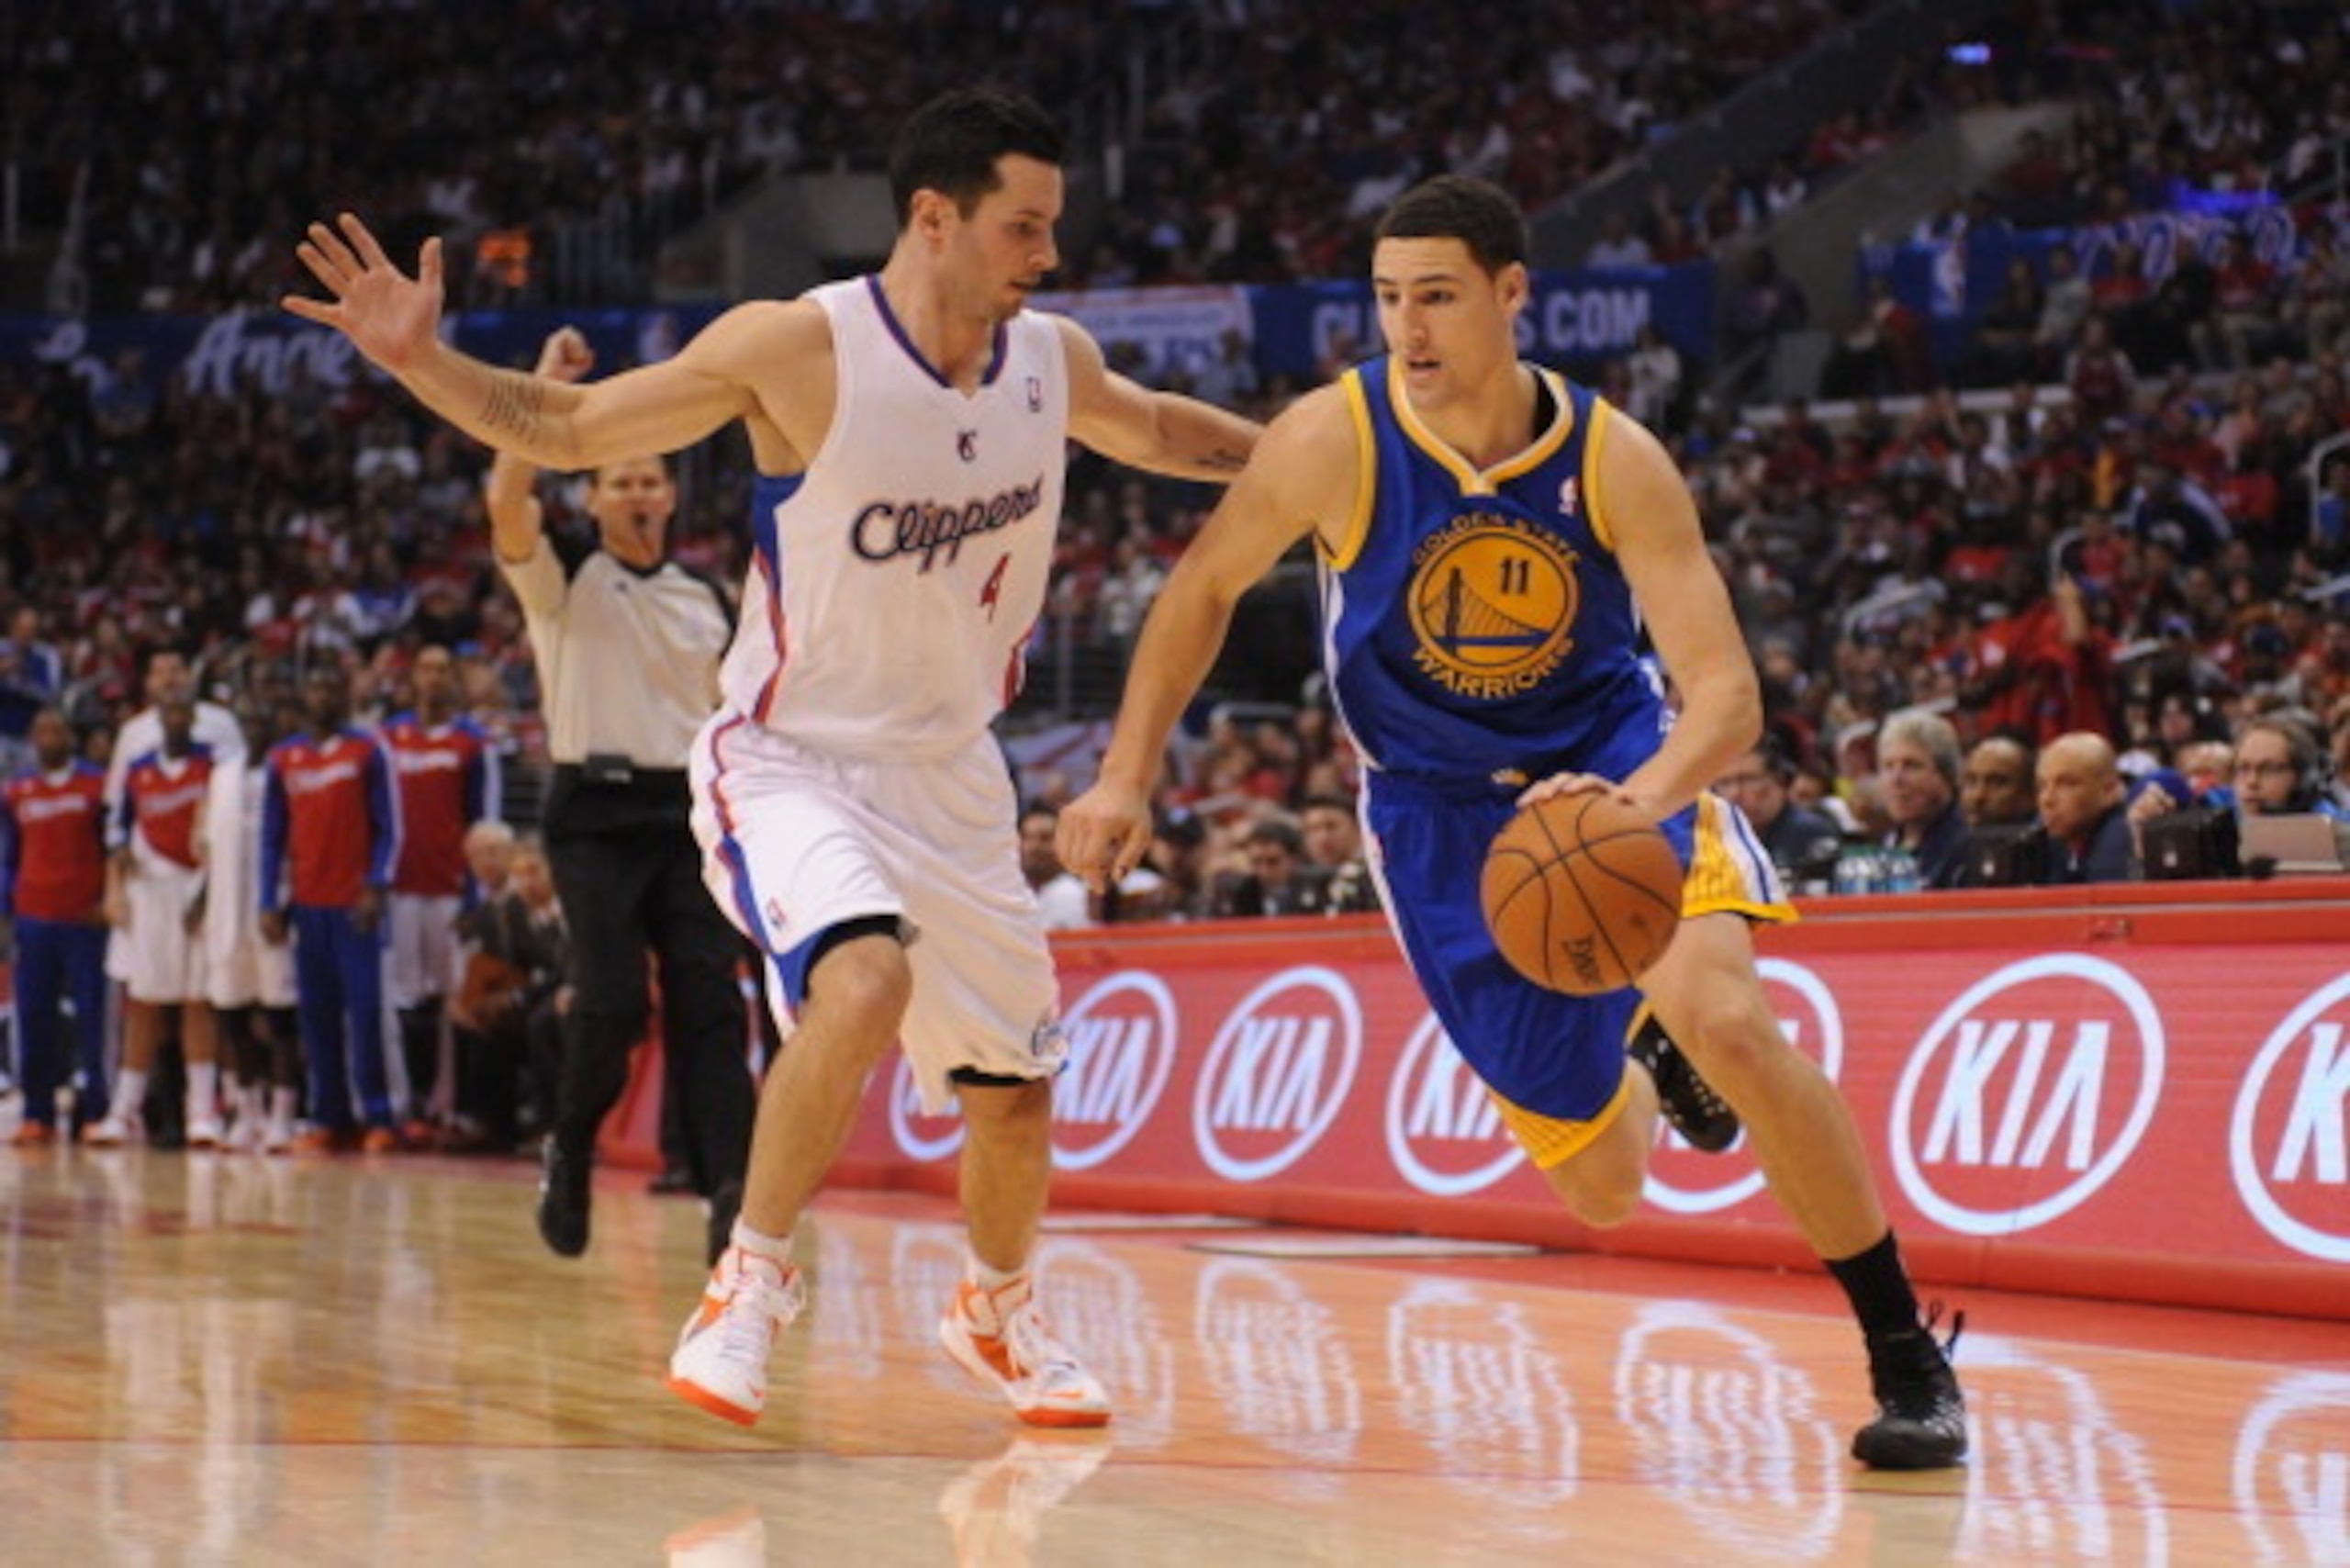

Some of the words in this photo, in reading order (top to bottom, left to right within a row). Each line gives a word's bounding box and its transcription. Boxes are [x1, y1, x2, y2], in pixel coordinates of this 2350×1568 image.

[850, 470, 1044, 576] Clippers
[1500, 556, 1530, 595] 11
[978, 551, 1012, 623] 4
[1212, 1015, 1331, 1129] KIA
[1920, 1020, 2110, 1170] KIA
